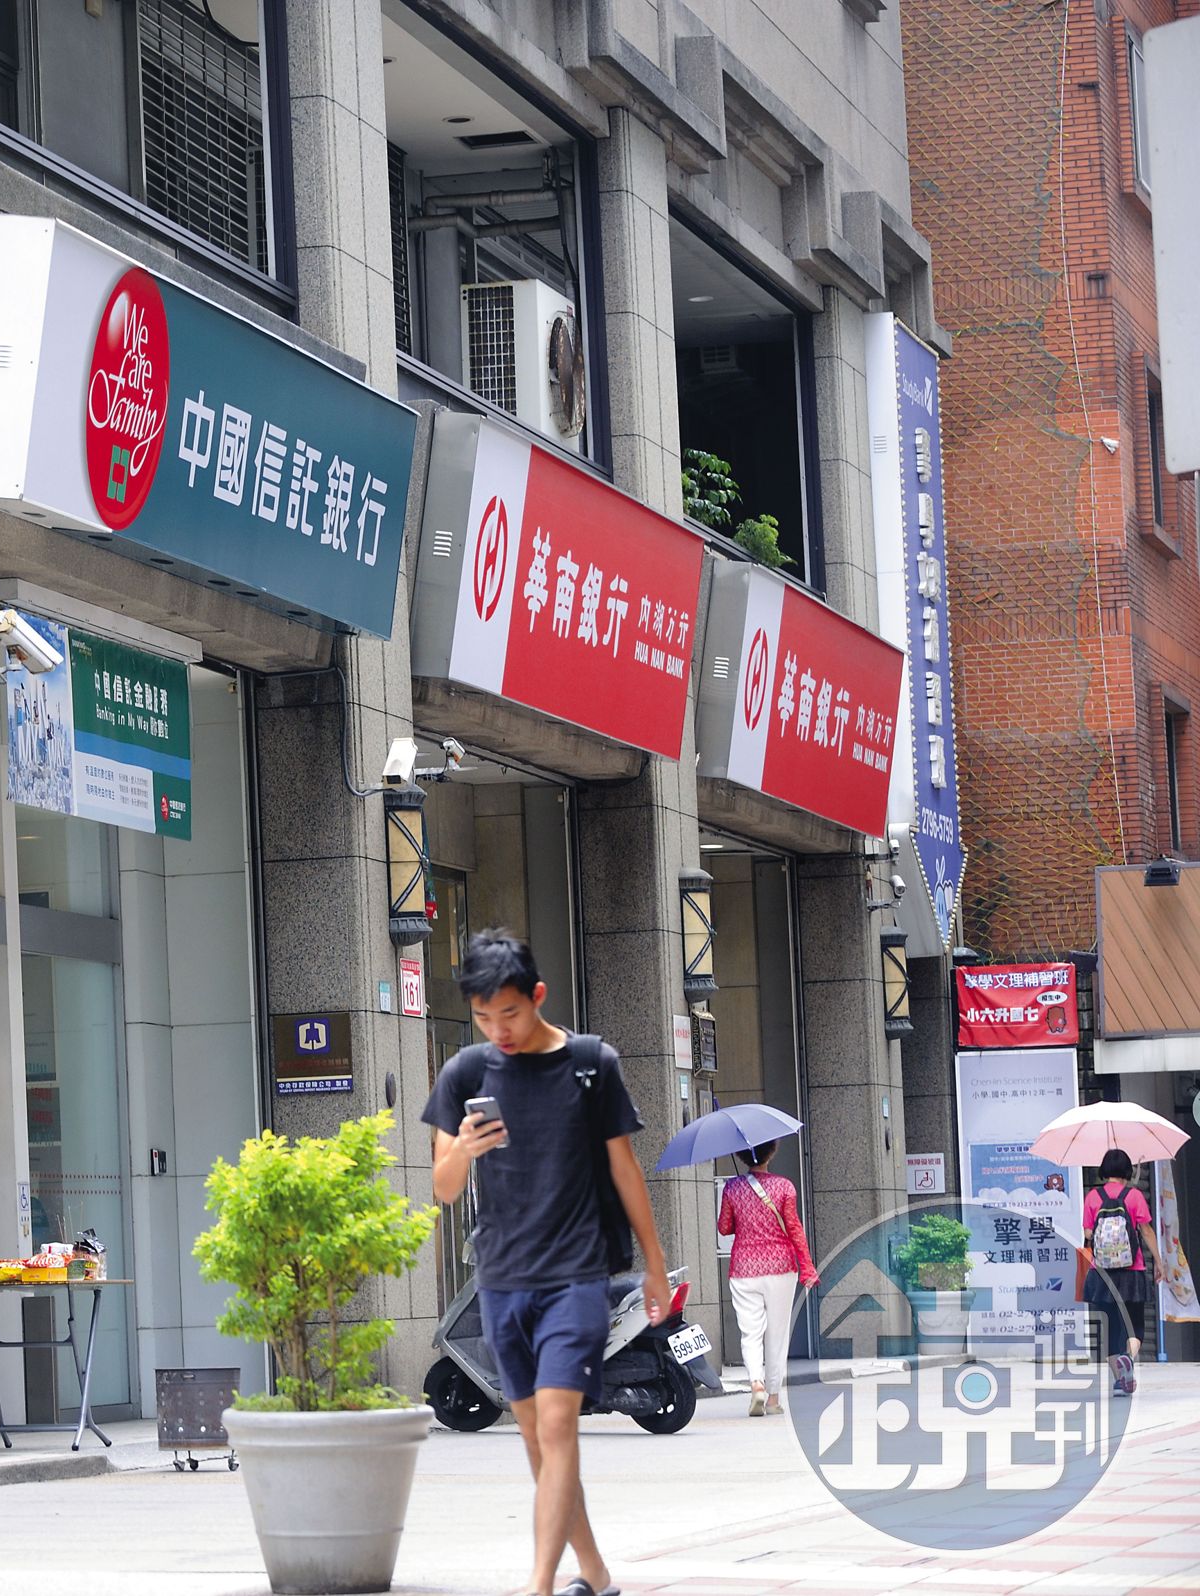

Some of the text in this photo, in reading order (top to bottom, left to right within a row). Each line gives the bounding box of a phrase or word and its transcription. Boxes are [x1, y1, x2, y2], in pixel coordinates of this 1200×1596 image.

[123, 298, 149, 358] We
[128, 354, 152, 394] are
[89, 349, 168, 477] Family
[178, 390, 389, 567] 中國信託銀行
[524, 526, 629, 659] 華南銀行
[634, 640, 685, 679] HUA NAN BANK
[118, 710, 126, 725] in
[128, 712, 136, 730] My
[137, 715, 149, 733] Way
[778, 650, 850, 757] 華南銀行
[853, 742, 863, 762] HUA
[875, 752, 889, 773] BANK
[921, 806, 954, 845] 2796-5759
[404, 981, 420, 1008] 161
[993, 1216, 1056, 1245] 擎學
[983, 1247, 1069, 1265] 文理補習班
